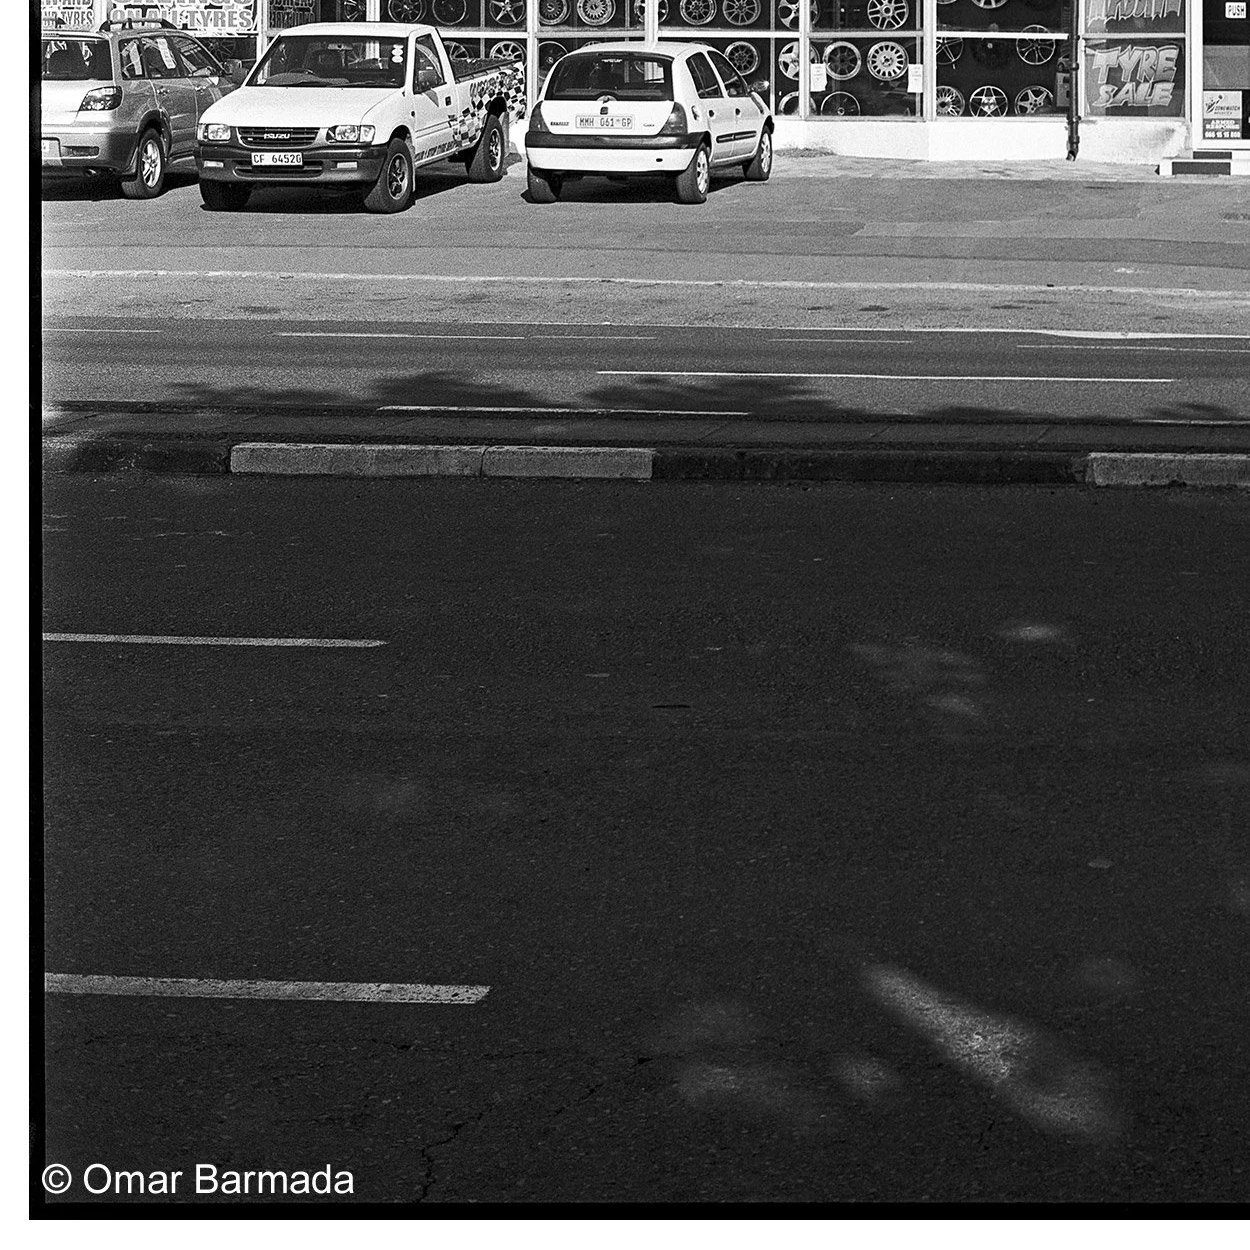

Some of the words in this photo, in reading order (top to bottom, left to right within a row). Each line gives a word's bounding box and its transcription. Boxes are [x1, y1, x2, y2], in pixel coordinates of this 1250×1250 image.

[1228, 5, 1245, 16] PUSH
[186, 10, 253, 28] TYRES
[1092, 44, 1180, 84] TYRE
[1092, 81, 1176, 107] SALE
[579, 117, 595, 127] MMH
[253, 153, 265, 164] CF
